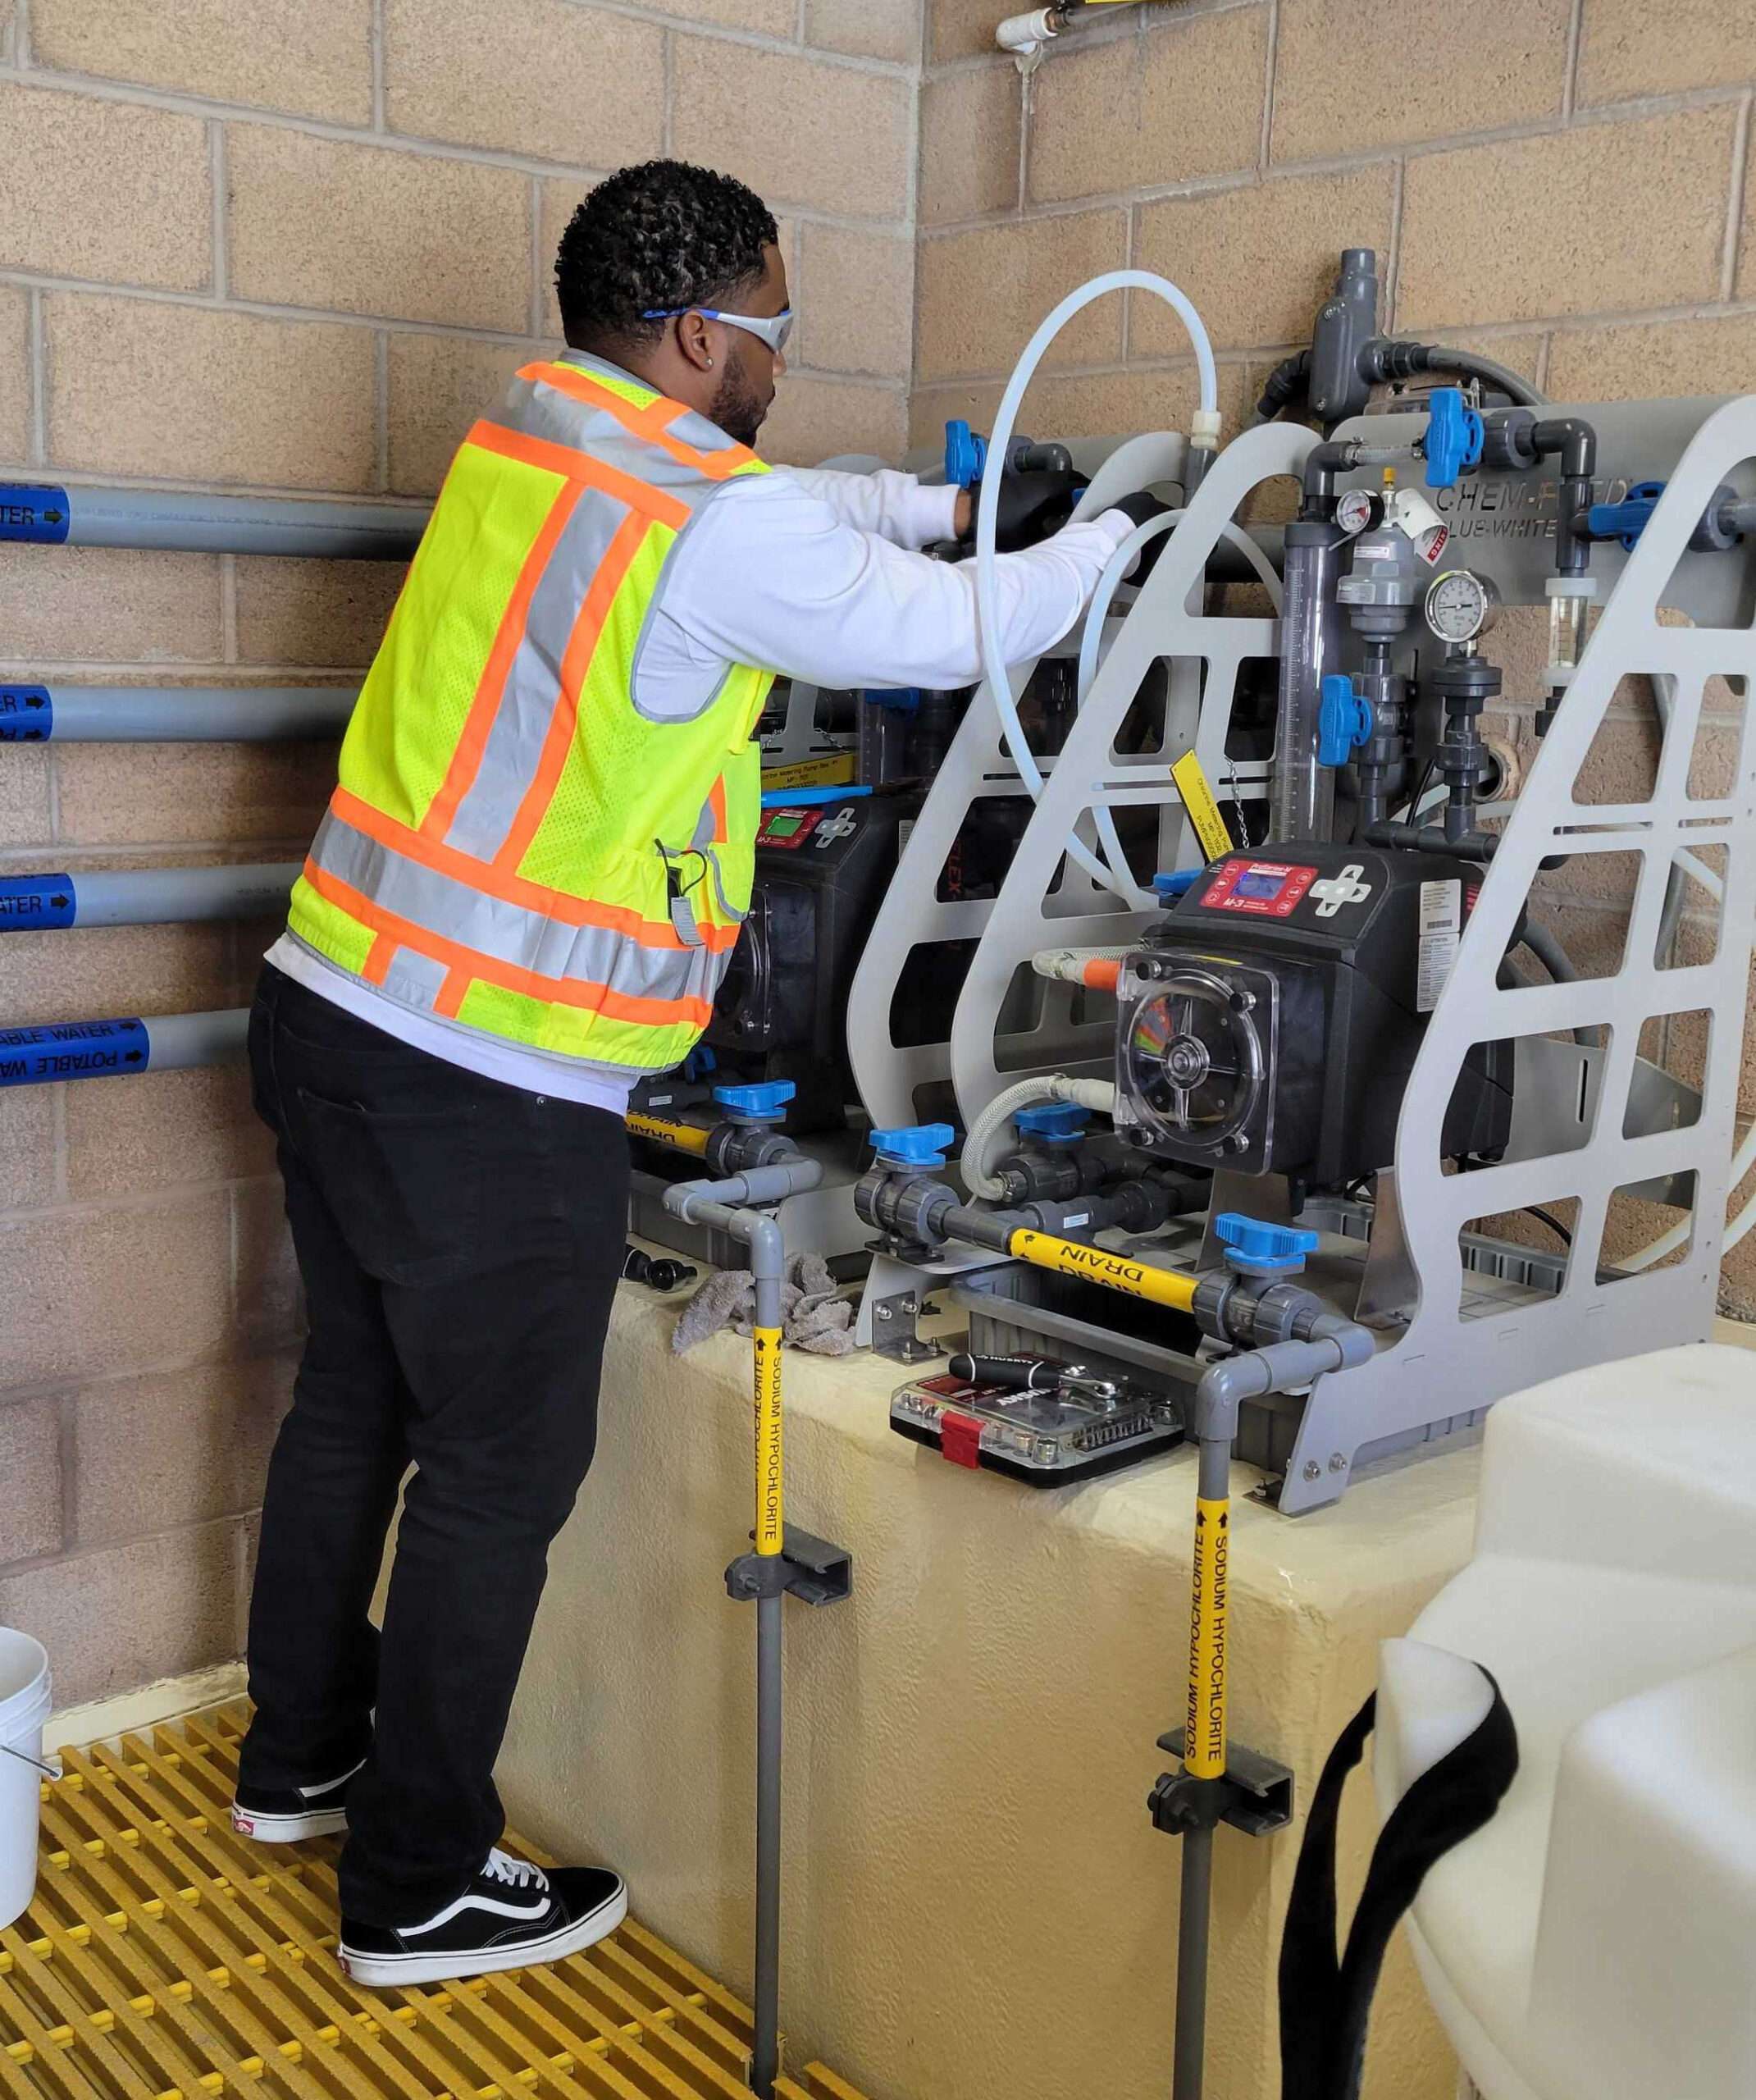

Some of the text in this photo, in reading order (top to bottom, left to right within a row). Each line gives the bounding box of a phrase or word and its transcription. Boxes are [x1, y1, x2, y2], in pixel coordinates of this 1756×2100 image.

[1436, 479, 1629, 511] CHEM-FD
[1448, 518, 1558, 538] LUE-WHITE
[36, 1050, 118, 1075] POTABLE
[1060, 1245, 1144, 1282] DRAIN
[764, 1356, 782, 1541] SODIUM HYPOCHLORITE
[1186, 1533, 1204, 1759] SODIUM HYPOCHLORITE
[1207, 1534, 1229, 1763] SODIUM HYPOCHLORITE
